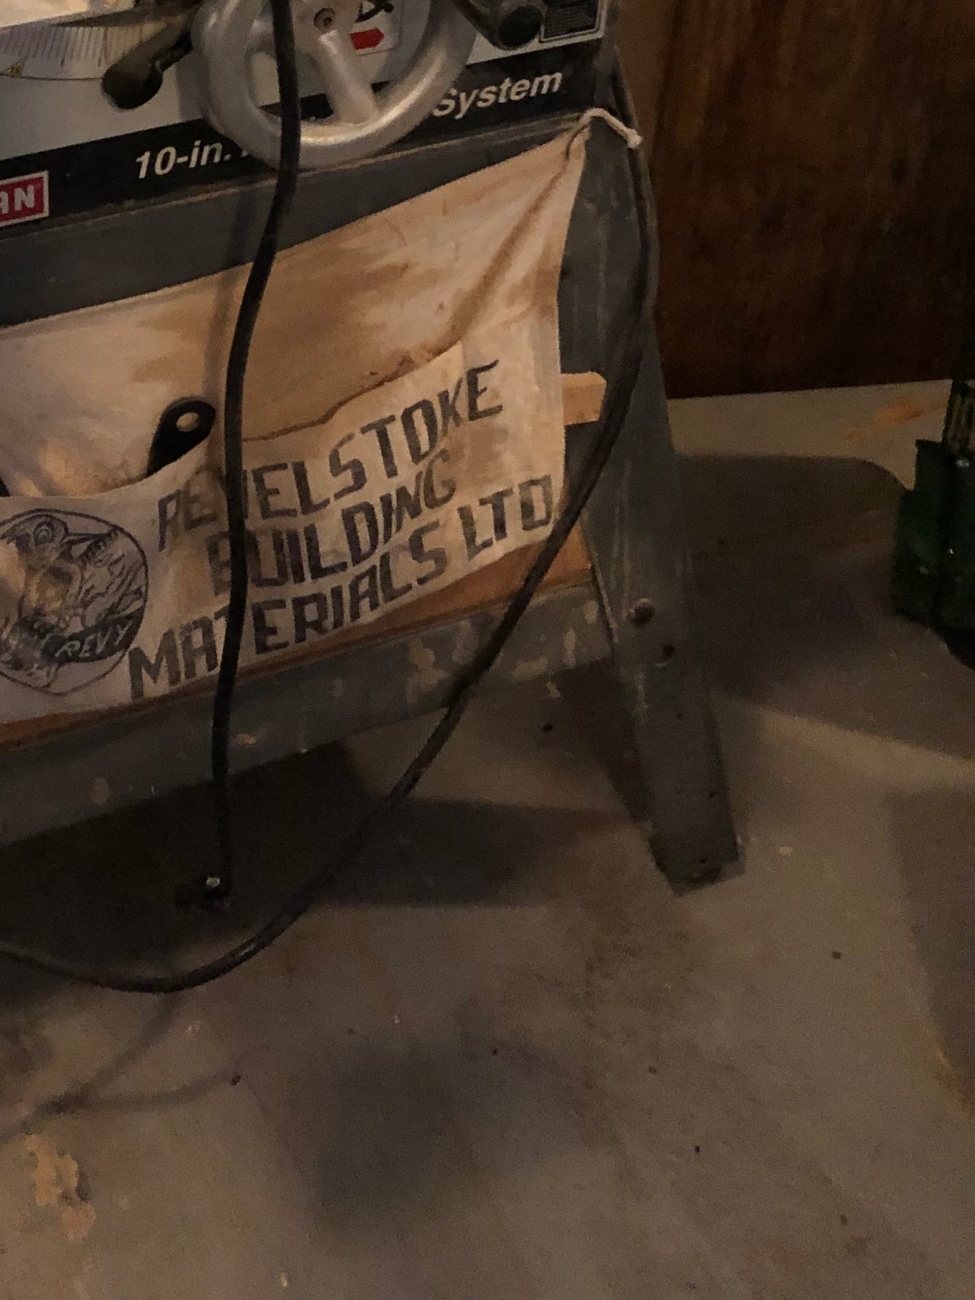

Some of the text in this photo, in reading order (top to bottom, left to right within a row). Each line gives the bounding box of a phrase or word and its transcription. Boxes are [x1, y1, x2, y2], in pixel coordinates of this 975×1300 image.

[136, 70, 563, 180] 10-in. System
[458, 475, 553, 560] LTD
[54, 619, 133, 658] REVY
